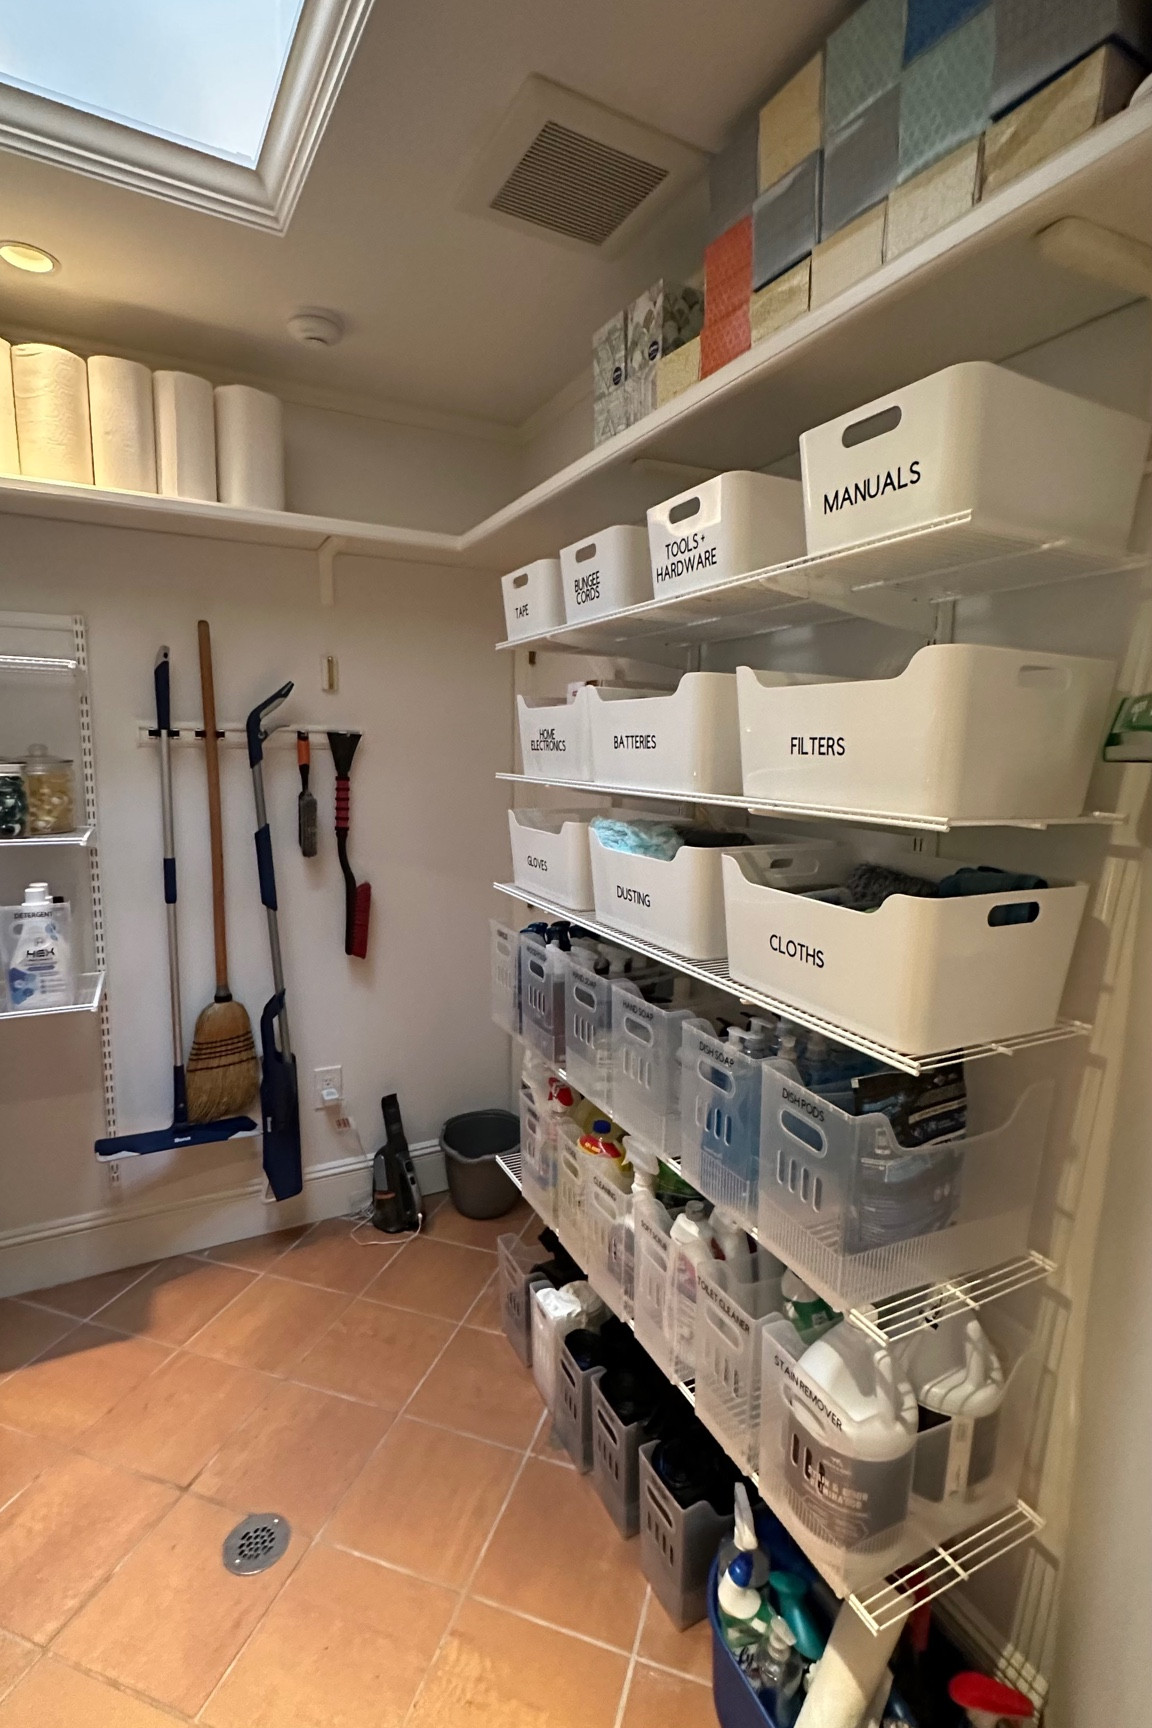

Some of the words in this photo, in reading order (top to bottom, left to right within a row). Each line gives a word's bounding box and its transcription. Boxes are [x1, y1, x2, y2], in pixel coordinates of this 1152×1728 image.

[823, 461, 921, 515] MANUALS
[665, 533, 699, 559] TOOLS
[656, 547, 718, 583] HARDWARE
[574, 570, 601, 593] BUNGEE
[576, 585, 600, 605] CORDS
[514, 603, 529, 619] TAPE
[539, 728, 556, 740] HOME
[613, 734, 657, 750] BATTERIES
[530, 739, 566, 752] ELECTRONICS
[790, 736, 846, 756] FILTERS
[527, 855, 548, 872] GLOVES
[616, 885, 651, 908] DUSTING
[14, 911, 53, 919] DETERGENT
[26, 948, 55, 958] HEX
[769, 934, 825, 969] CLOTHS
[622, 1001, 638, 1014] HAND
[638, 1007, 654, 1021] SOAP
[699, 1041, 714, 1056] DISH
[714, 1050, 735, 1068] SOAP
[782, 1087, 800, 1108] DISH
[801, 1099, 825, 1122] PODS
[697, 1275, 718, 1302] TOILET
[719, 1298, 750, 1335] CLEANER
[774, 1354, 799, 1386] STAIN
[799, 1379, 843, 1432] REMOVER
